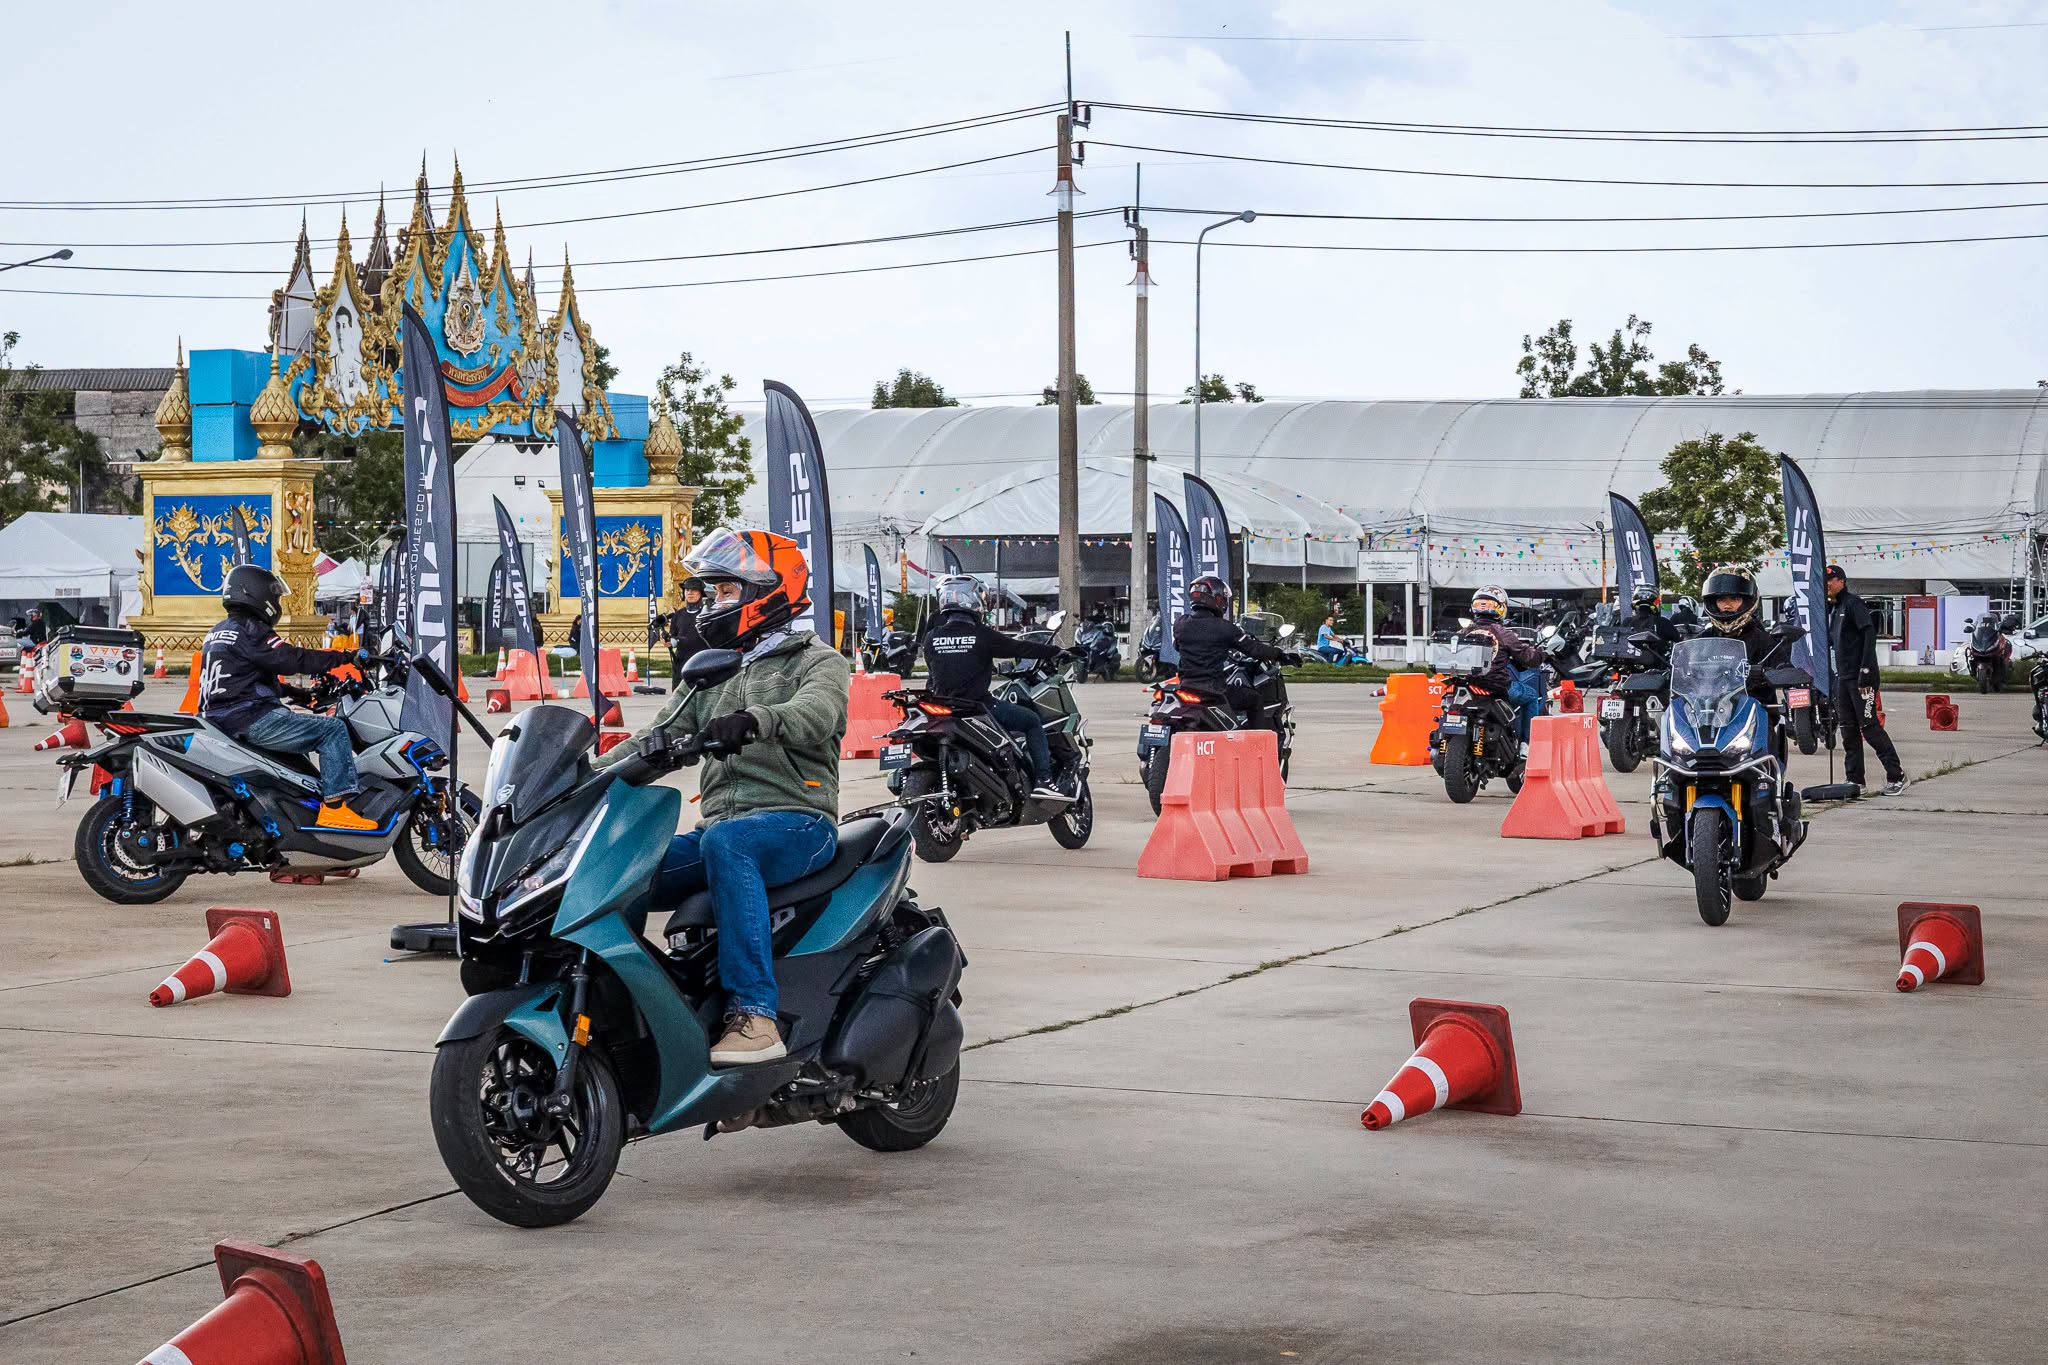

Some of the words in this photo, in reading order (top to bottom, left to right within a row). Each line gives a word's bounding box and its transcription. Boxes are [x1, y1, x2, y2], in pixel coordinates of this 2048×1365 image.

[493, 569, 501, 629] ZONTES
[202, 629, 240, 643] NTES
[932, 636, 976, 646] ZONTES
[1428, 685, 1443, 694] SCT
[1583, 716, 1594, 729] HCT
[1196, 740, 1216, 756] HCT
